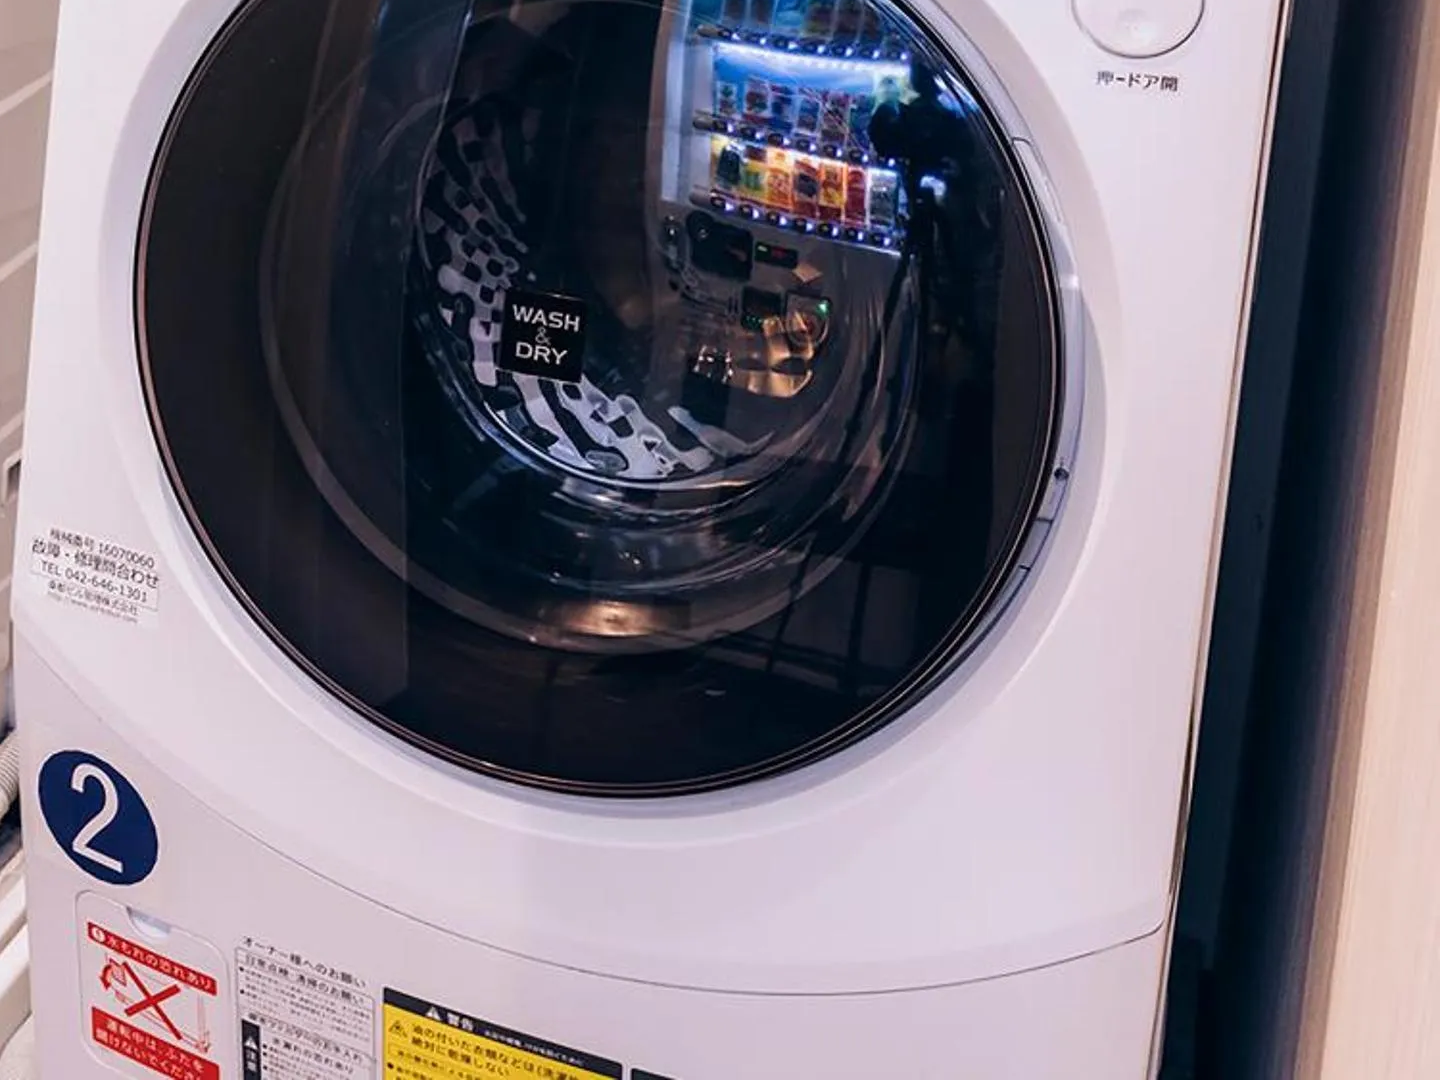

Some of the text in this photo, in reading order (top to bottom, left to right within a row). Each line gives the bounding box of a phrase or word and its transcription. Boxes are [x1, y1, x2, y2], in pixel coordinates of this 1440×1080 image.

[512, 304, 580, 332] WASH
[515, 341, 568, 365] DRY
[40, 560, 61, 576] TEL
[64, 567, 148, 603] 042-646-1301
[70, 762, 123, 873] 2
